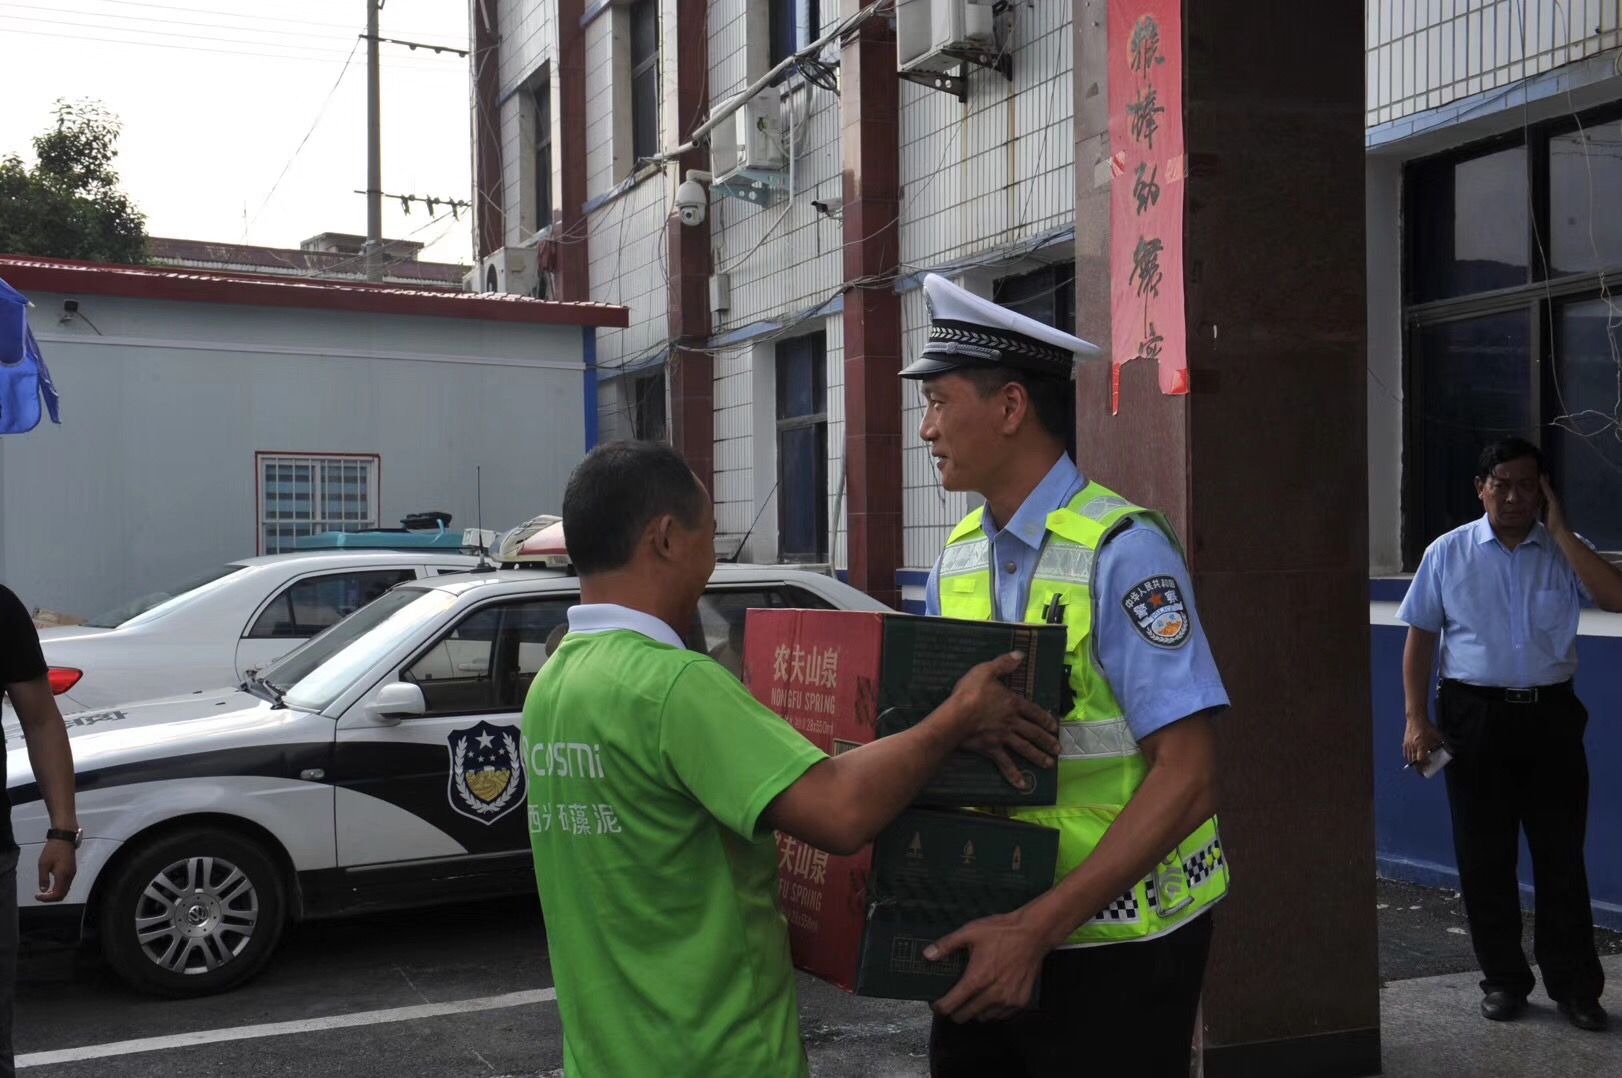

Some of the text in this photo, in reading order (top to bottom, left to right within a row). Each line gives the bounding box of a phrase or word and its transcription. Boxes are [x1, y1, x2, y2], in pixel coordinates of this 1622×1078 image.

[1125, 579, 1176, 608] 中华人民共和国
[773, 643, 838, 688] 农夫山泉
[805, 692, 835, 715] SPRING
[774, 829, 830, 885] 夫山泉
[791, 884, 822, 911] SPRING
